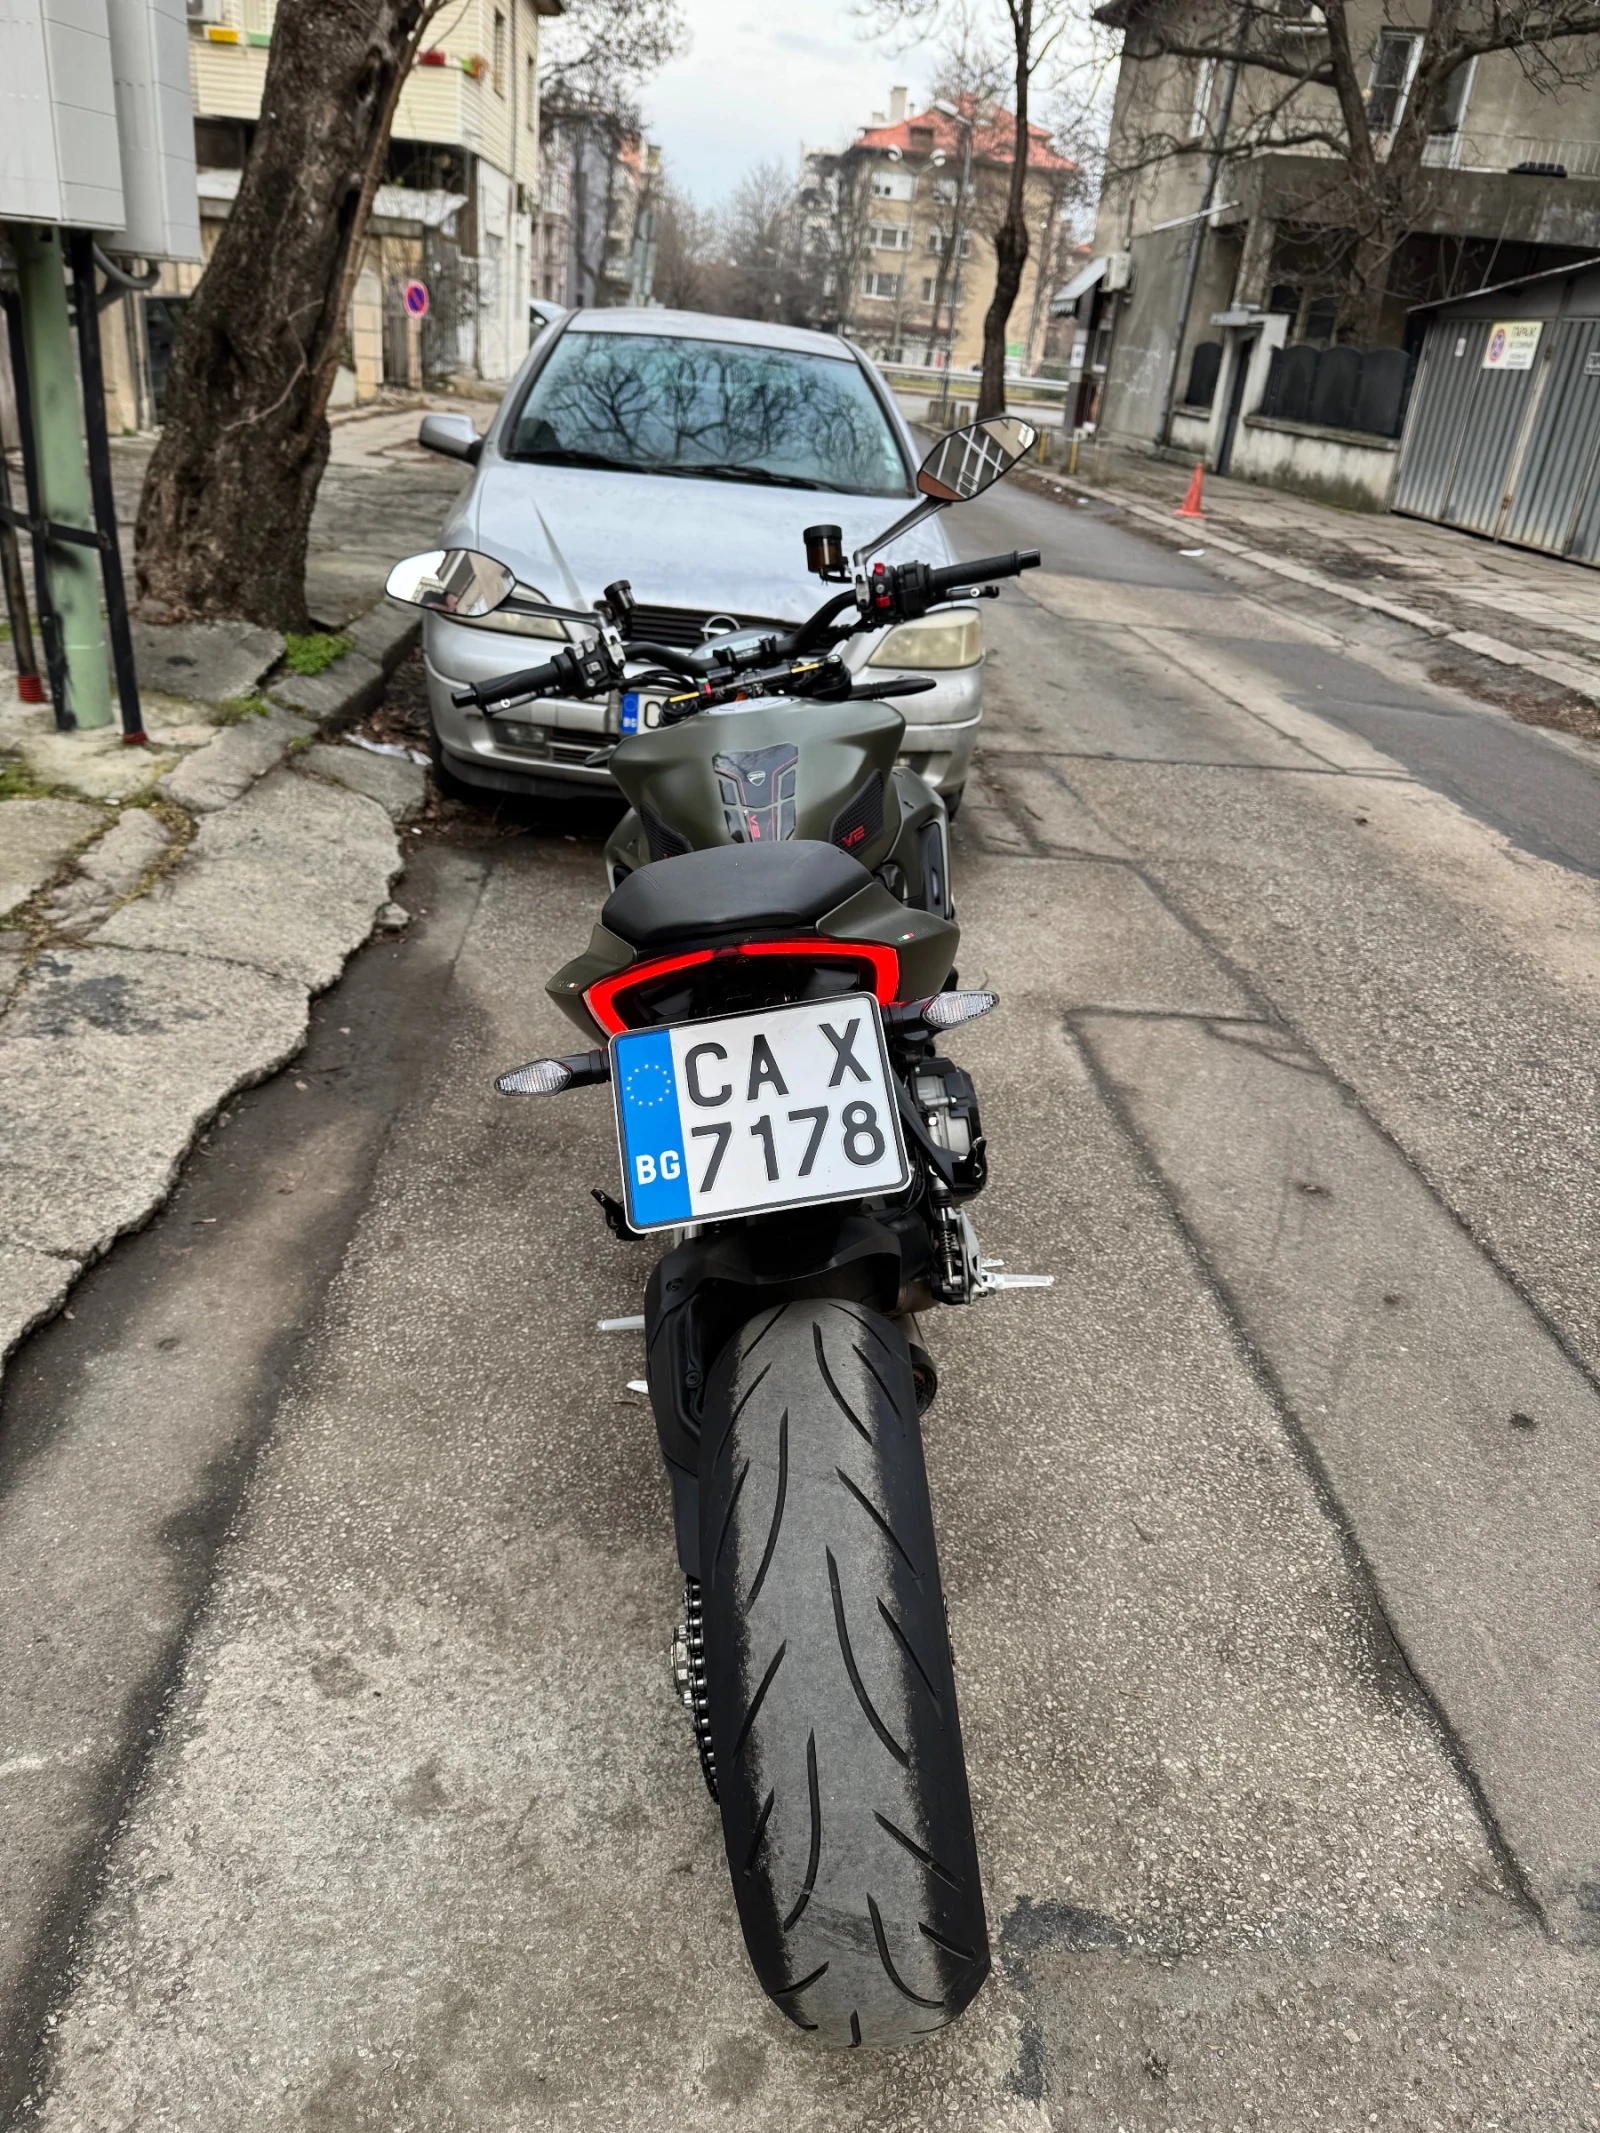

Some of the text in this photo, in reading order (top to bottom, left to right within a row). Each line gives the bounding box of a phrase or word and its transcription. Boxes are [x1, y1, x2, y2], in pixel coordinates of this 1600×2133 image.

[684, 1017, 872, 1108] CA X
[635, 1150, 681, 1185] BG
[690, 1100, 886, 1193] 7178
